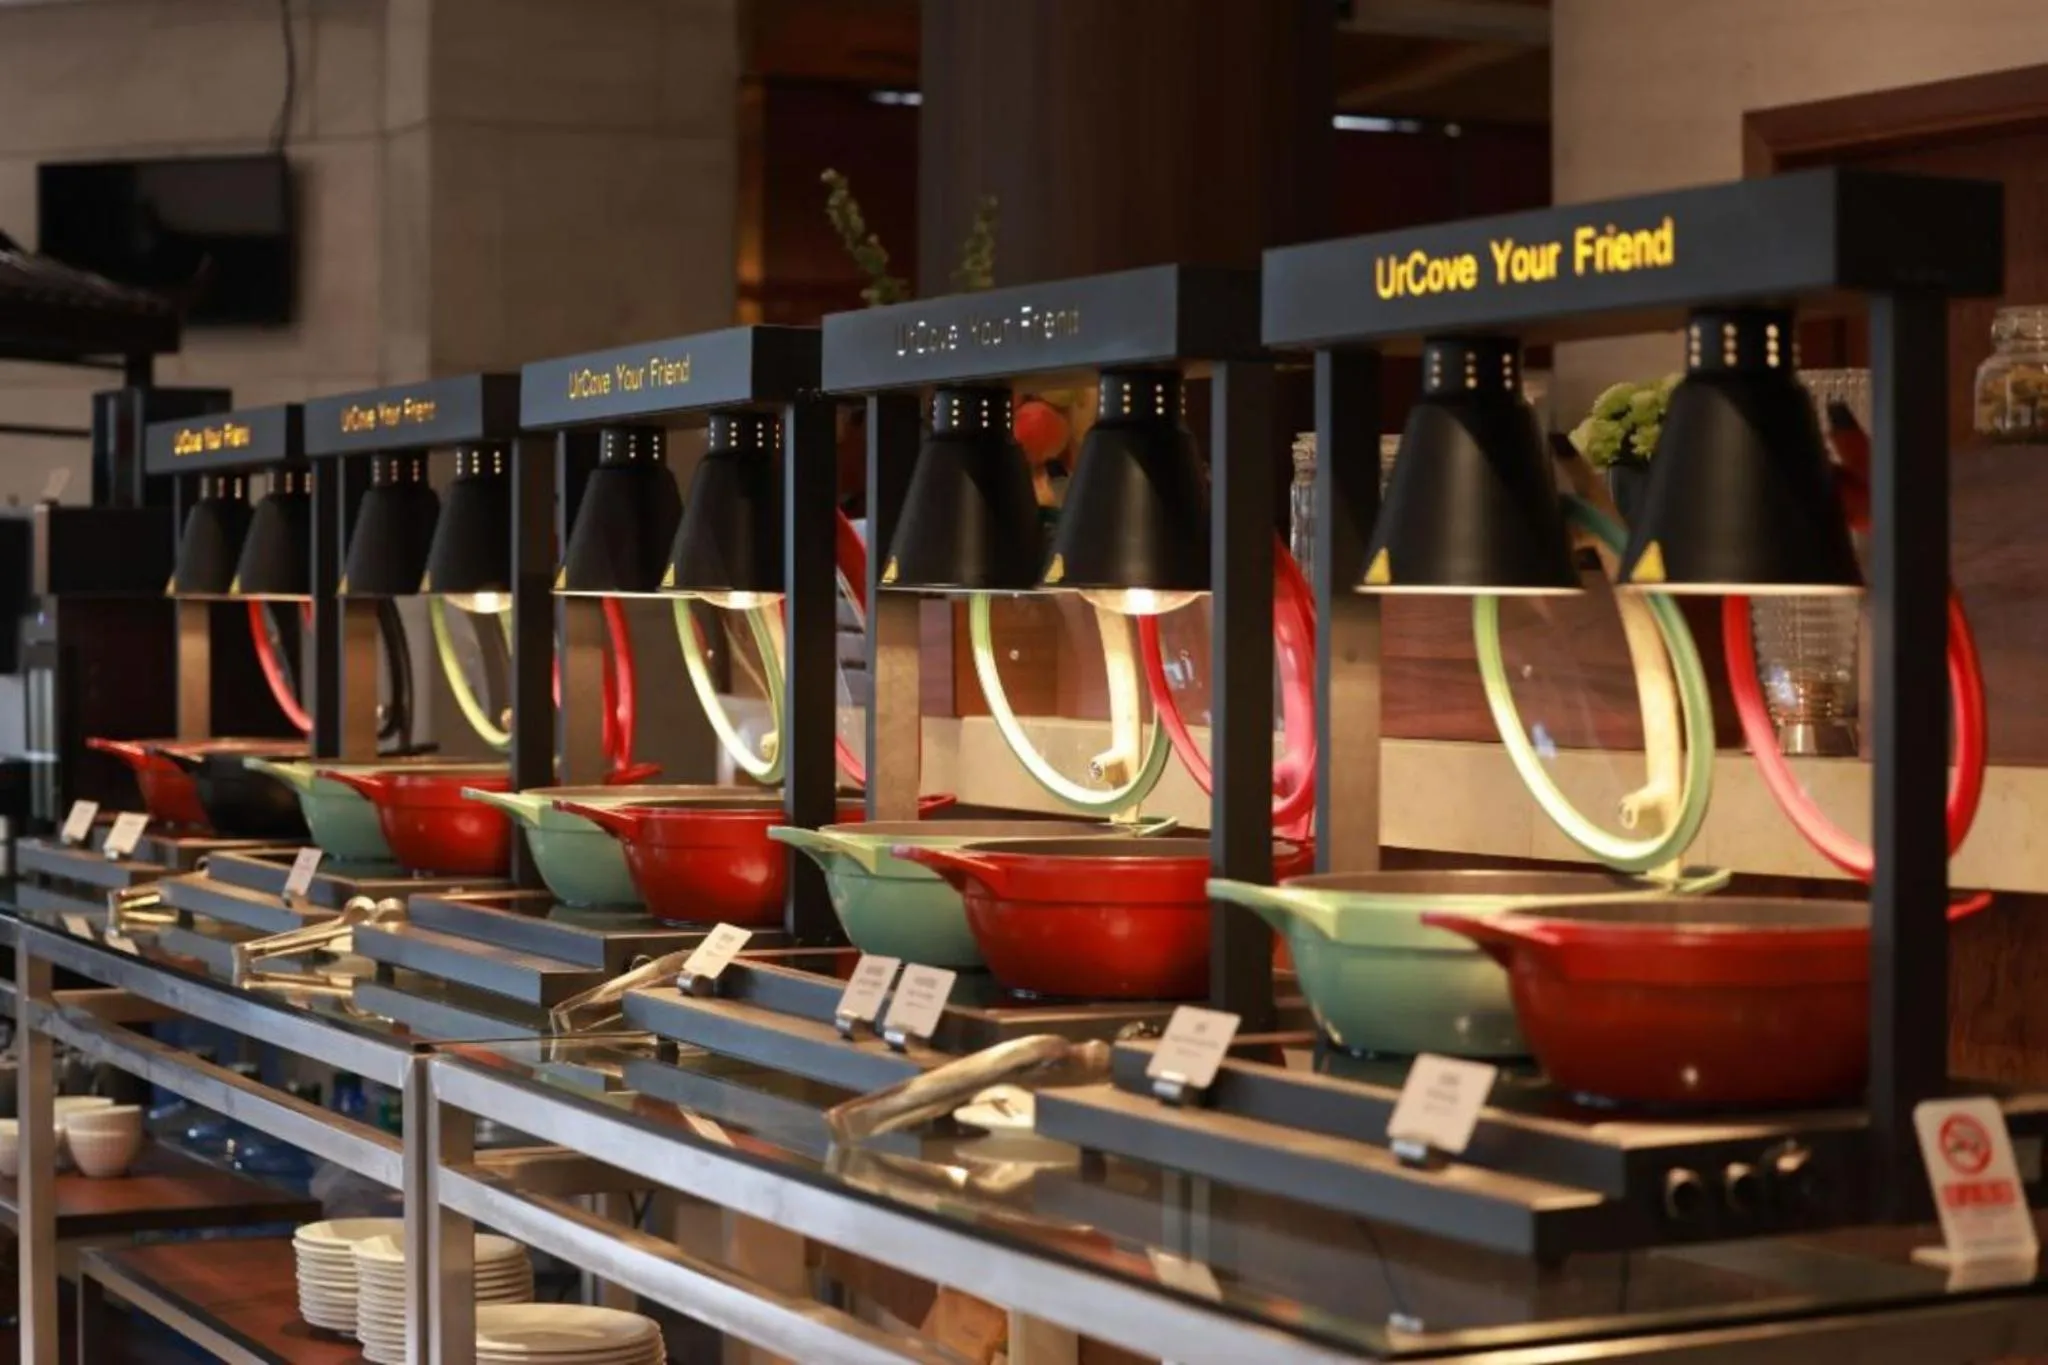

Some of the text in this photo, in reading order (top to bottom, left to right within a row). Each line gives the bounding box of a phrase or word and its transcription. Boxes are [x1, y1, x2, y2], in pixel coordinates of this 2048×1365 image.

[1375, 215, 1674, 299] UrCove Your Friend
[569, 352, 690, 399] UrCove Your Friend
